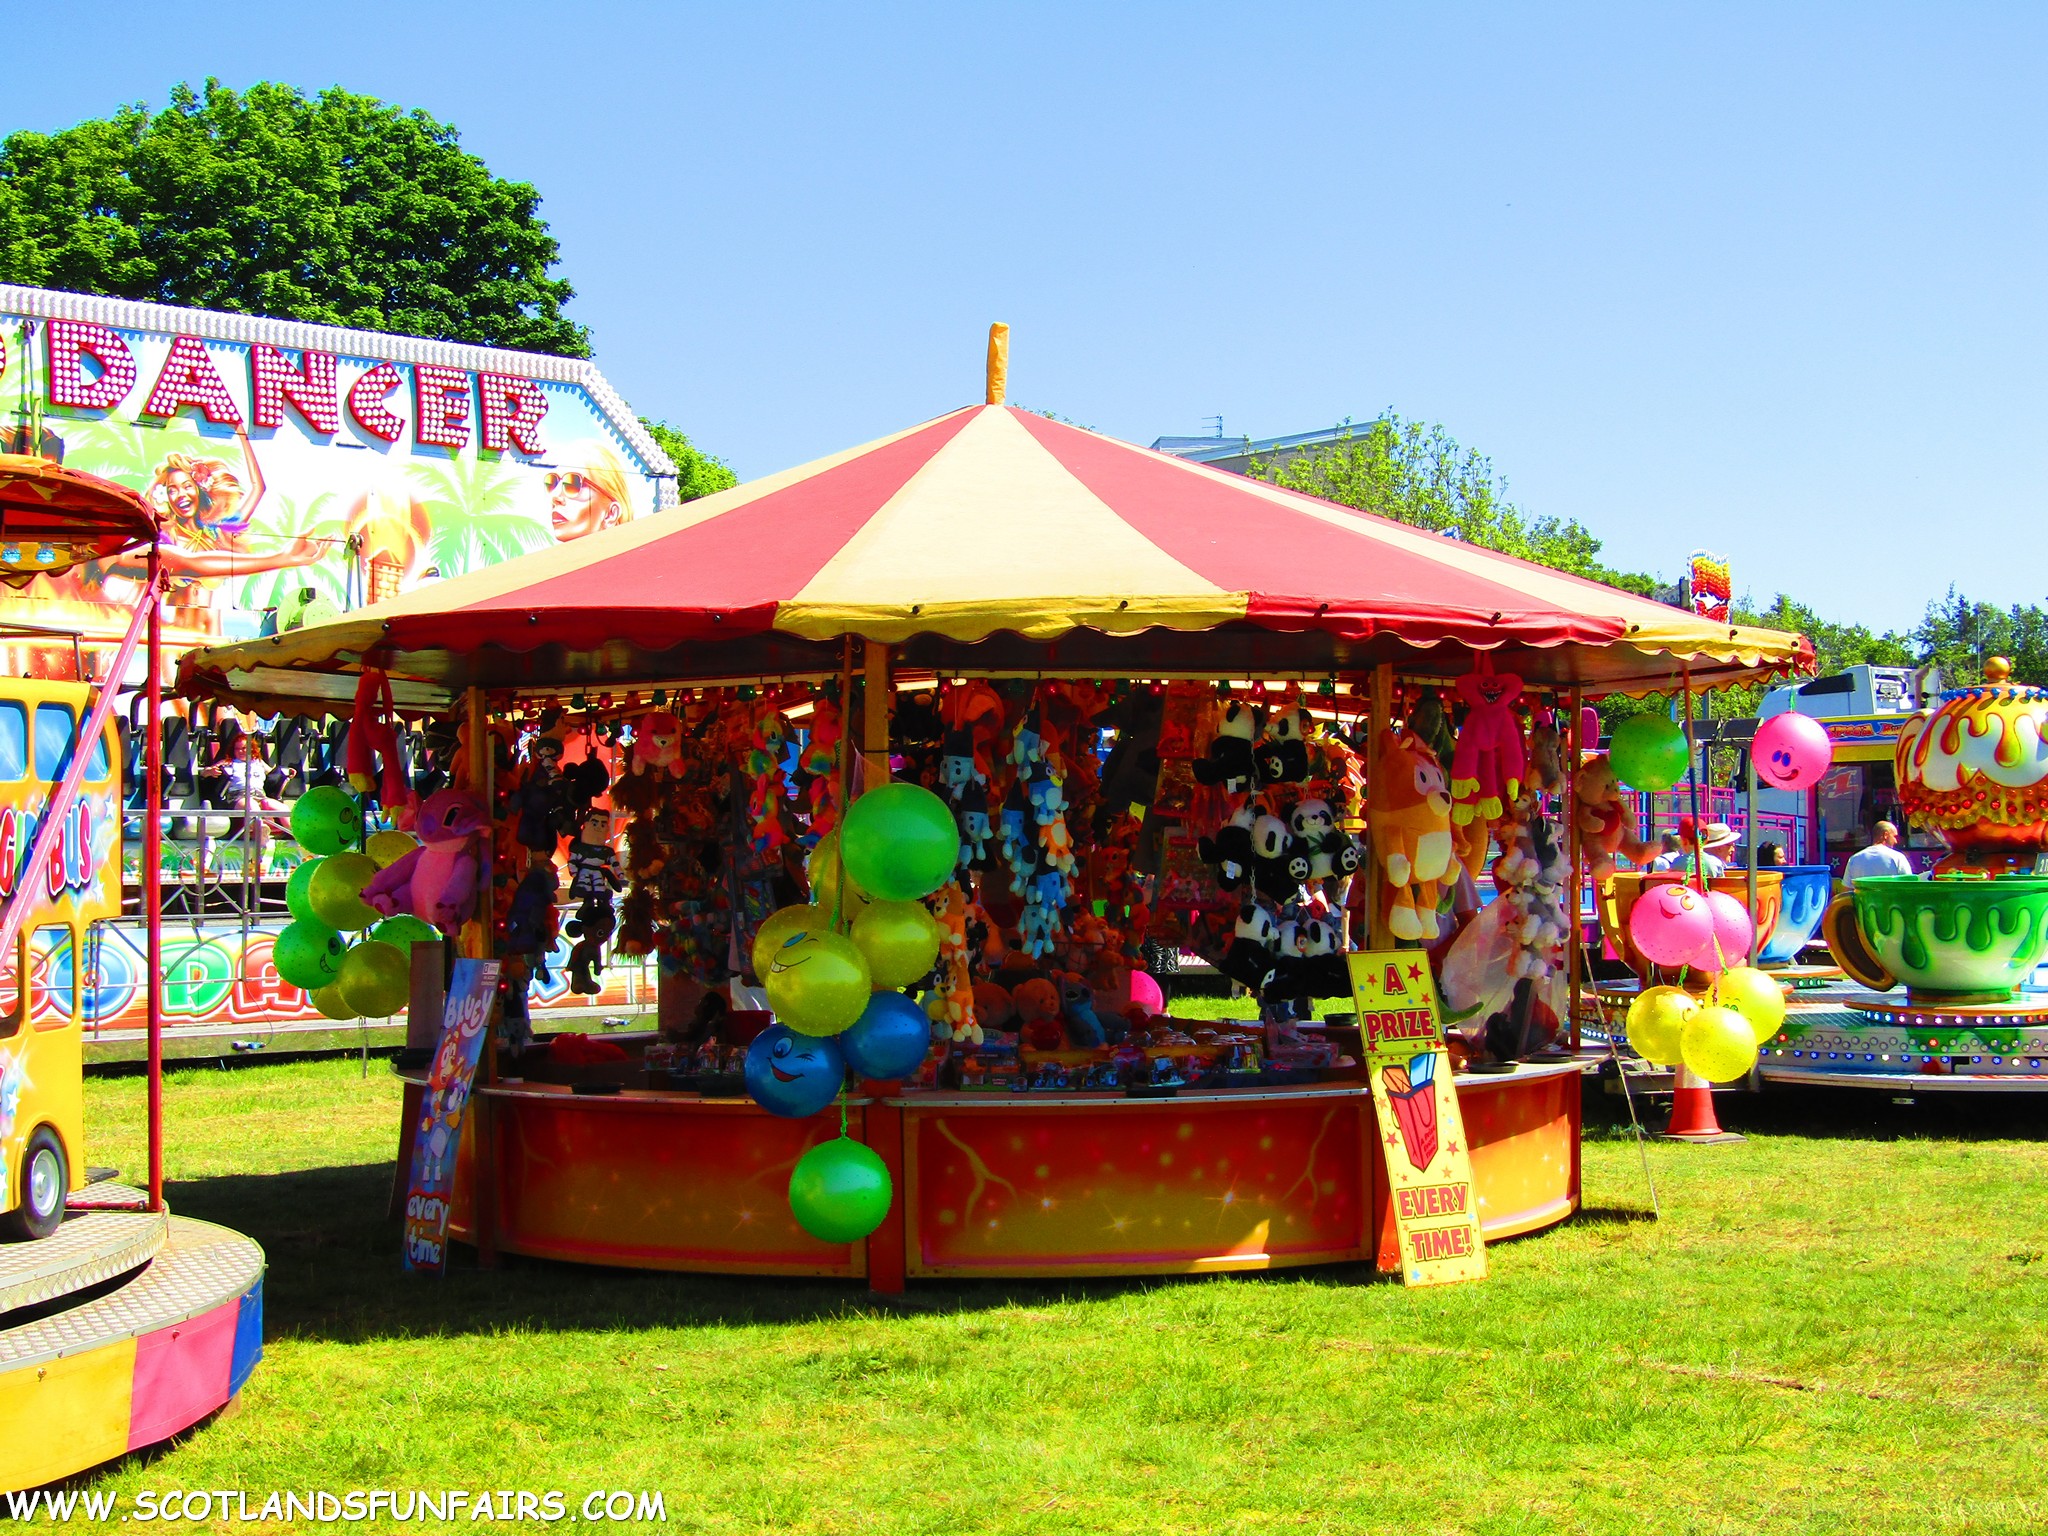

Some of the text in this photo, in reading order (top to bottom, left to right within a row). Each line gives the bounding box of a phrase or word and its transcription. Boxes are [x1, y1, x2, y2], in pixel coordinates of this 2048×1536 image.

[45, 317, 548, 456] DANCER
[1383, 963, 1407, 996] A
[444, 989, 494, 1038] BLUEY
[1363, 1008, 1438, 1043] PRIZE
[407, 1194, 450, 1237] every
[1396, 1181, 1469, 1220] EVERY
[408, 1225, 441, 1264] time
[1408, 1224, 1475, 1262] TIME!
